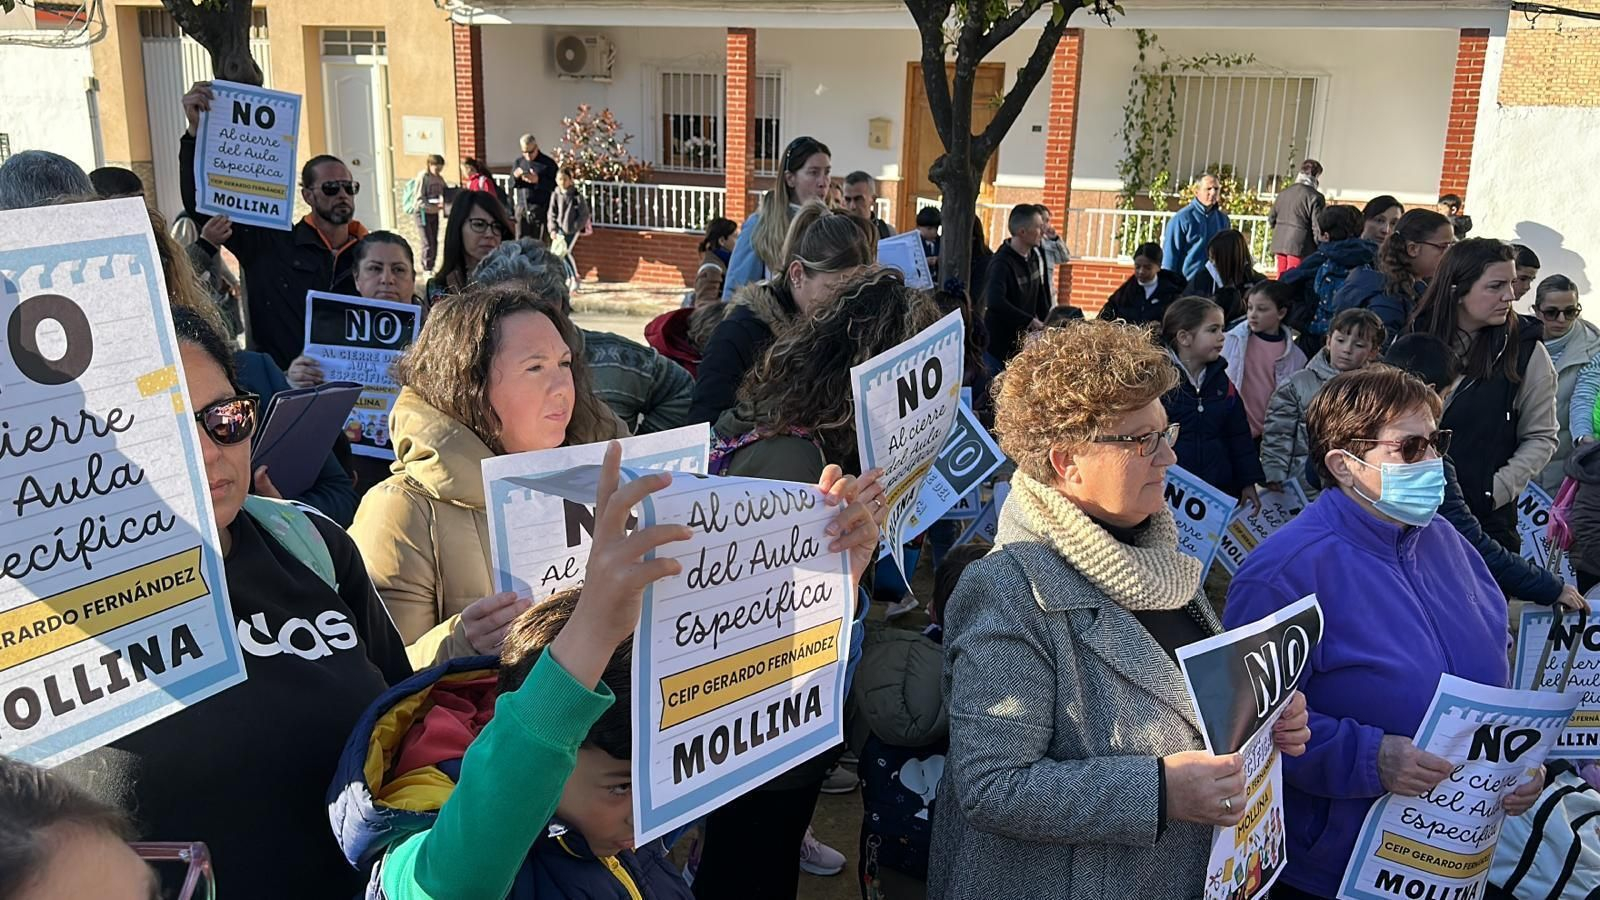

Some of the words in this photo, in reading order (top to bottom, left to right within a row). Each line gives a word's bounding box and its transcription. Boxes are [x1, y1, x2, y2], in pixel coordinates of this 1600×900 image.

[233, 100, 275, 129] NO
[218, 142, 242, 156] del
[244, 147, 279, 163] Aula
[219, 128, 237, 141] Al
[239, 133, 280, 148] cierre
[212, 158, 284, 178] Específica
[213, 192, 280, 215] MOLLINA
[0, 294, 94, 394] O
[345, 308, 402, 344] NO
[896, 356, 943, 419] NO
[888, 426, 908, 455] Al
[909, 404, 946, 441] cierre
[885, 447, 909, 476] del
[13, 453, 144, 516] Aula
[1164, 482, 1206, 520] NO
[687, 491, 728, 533] Al
[733, 487, 816, 527] cierre
[1517, 494, 1550, 526] NO
[0, 510, 175, 579] ecífica
[1175, 520, 1204, 540] erre
[541, 556, 580, 586] Al
[687, 541, 744, 589] del
[748, 524, 820, 576] Aula
[0, 609, 79, 650] RARDO
[82, 567, 196, 619] FERNÁNDEZ
[675, 580, 833, 650] Específica
[0, 623, 203, 739] OLLINA
[668, 684, 700, 707] CEIP
[702, 661, 766, 695] GERARDO
[767, 634, 835, 670] FERNÁNDEZ
[1243, 625, 1309, 719] NO
[672, 684, 823, 785] MOLLINA
[1466, 724, 1542, 763] NO
[1449, 764, 1465, 782] l
[1384, 842, 1411, 856] CEIP
[1411, 851, 1463, 870] GERARDO
[1374, 868, 1486, 900] MOLLINA
